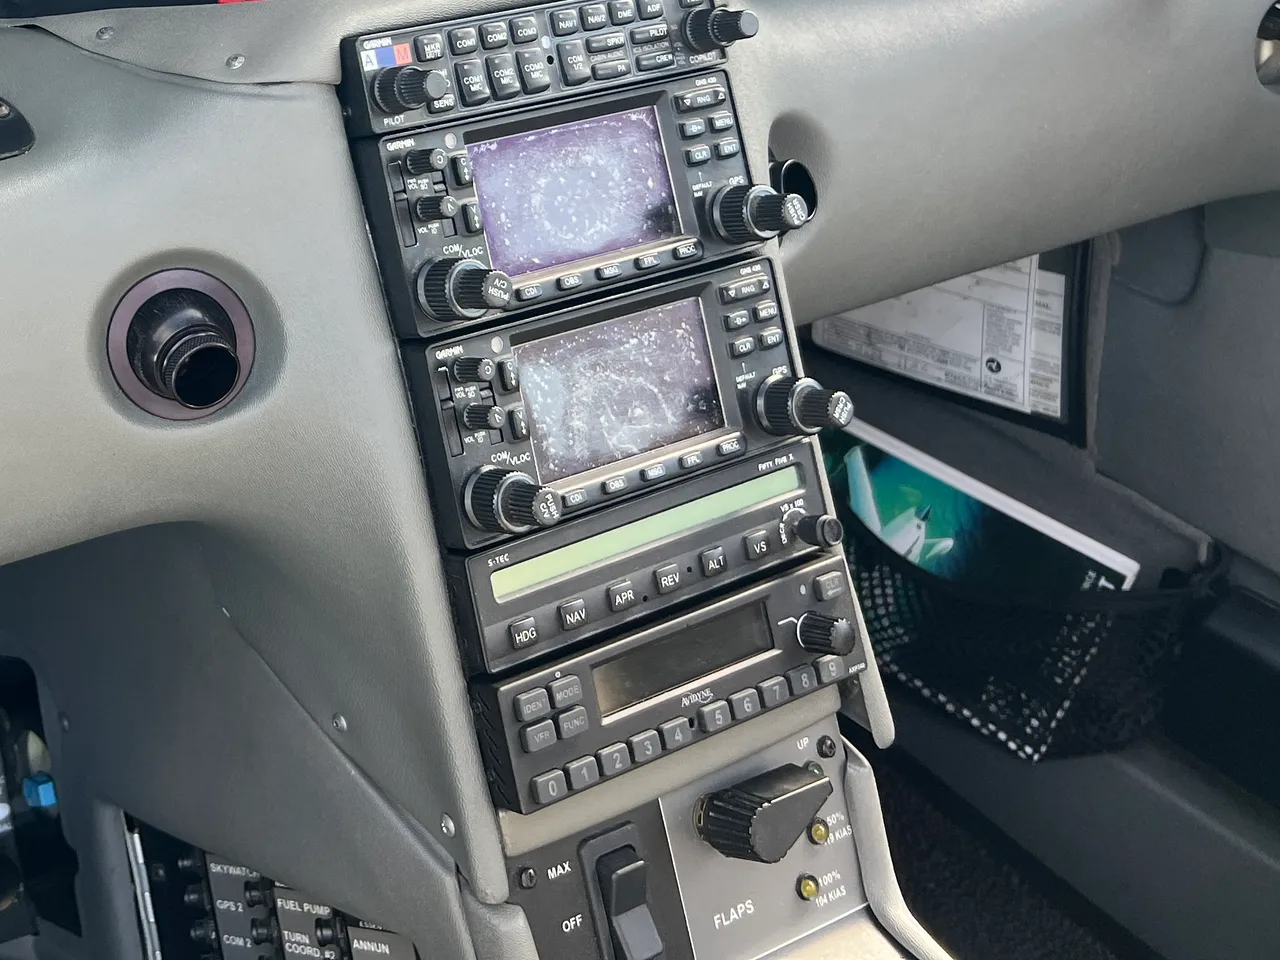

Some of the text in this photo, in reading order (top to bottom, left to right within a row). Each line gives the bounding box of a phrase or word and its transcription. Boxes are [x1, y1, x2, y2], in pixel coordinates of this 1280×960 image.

[618, 9, 633, 19] DME
[647, 3, 661, 13] ADF
[559, 19, 577, 29] NAV1
[588, 14, 606, 24] NAV2
[649, 26, 668, 37] PILOT
[363, 37, 392, 50] GARMIN
[456, 38, 476, 48] COM1
[689, 52, 716, 64] COPILOT
[715, 116, 734, 127] MENU
[729, 174, 744, 186] GPS
[679, 245, 696, 256] PROC
[564, 275, 579, 286] OBS
[753, 541, 767, 554] VS
[487, 553, 510, 567] S-TEC
[707, 555, 724, 571] ALT
[661, 571, 680, 588] REV
[614, 589, 635, 606] APR
[566, 608, 587, 625] NAV
[514, 626, 537, 644] HDG
[555, 684, 580, 700] MODE
[681, 689, 712, 708] AVIDYNE
[796, 737, 810, 751] UP
[547, 861, 572, 880] MAX
[815, 886, 847, 908] 104 KIAS
[277, 898, 331, 916] FUEL PUMP
[713, 898, 756, 930] FLAPS
[562, 914, 583, 933] OFF
[353, 939, 391, 955] ANNUN
